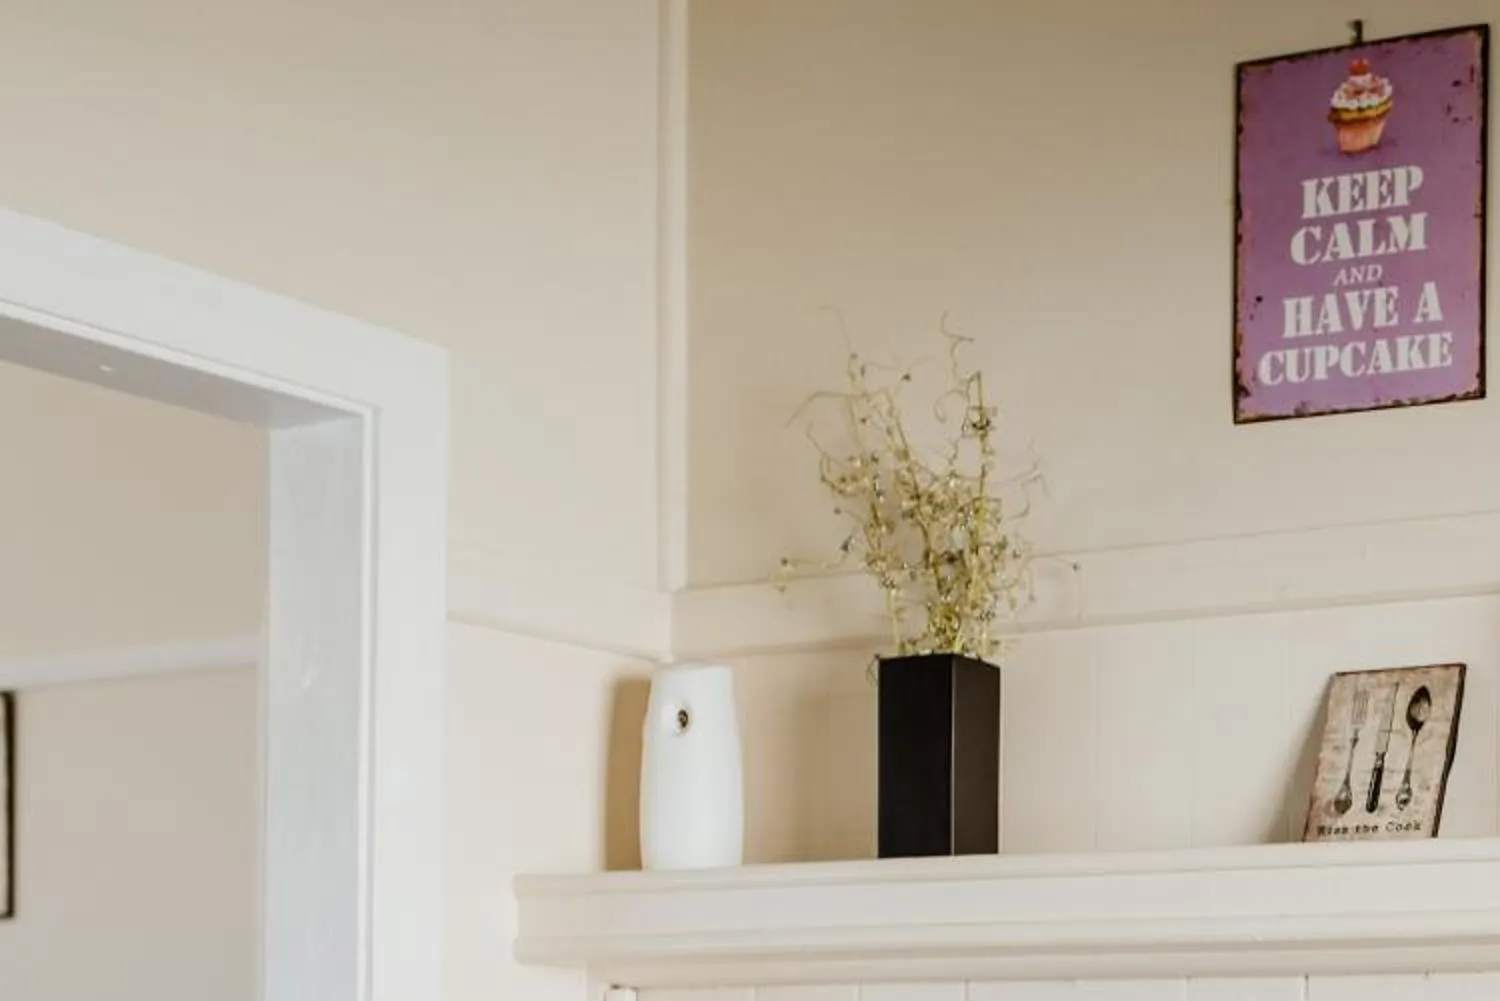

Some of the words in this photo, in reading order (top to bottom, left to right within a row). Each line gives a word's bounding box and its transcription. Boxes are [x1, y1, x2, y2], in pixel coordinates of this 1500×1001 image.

[1301, 165, 1423, 218] KEEP
[1290, 212, 1428, 266] CALM
[1333, 265, 1383, 286] AND
[1283, 286, 1399, 339] HAVE
[1413, 281, 1444, 324] A
[1258, 332, 1453, 387] CUPCAKE
[1354, 823, 1379, 834] the
[1385, 820, 1421, 833] Cook
